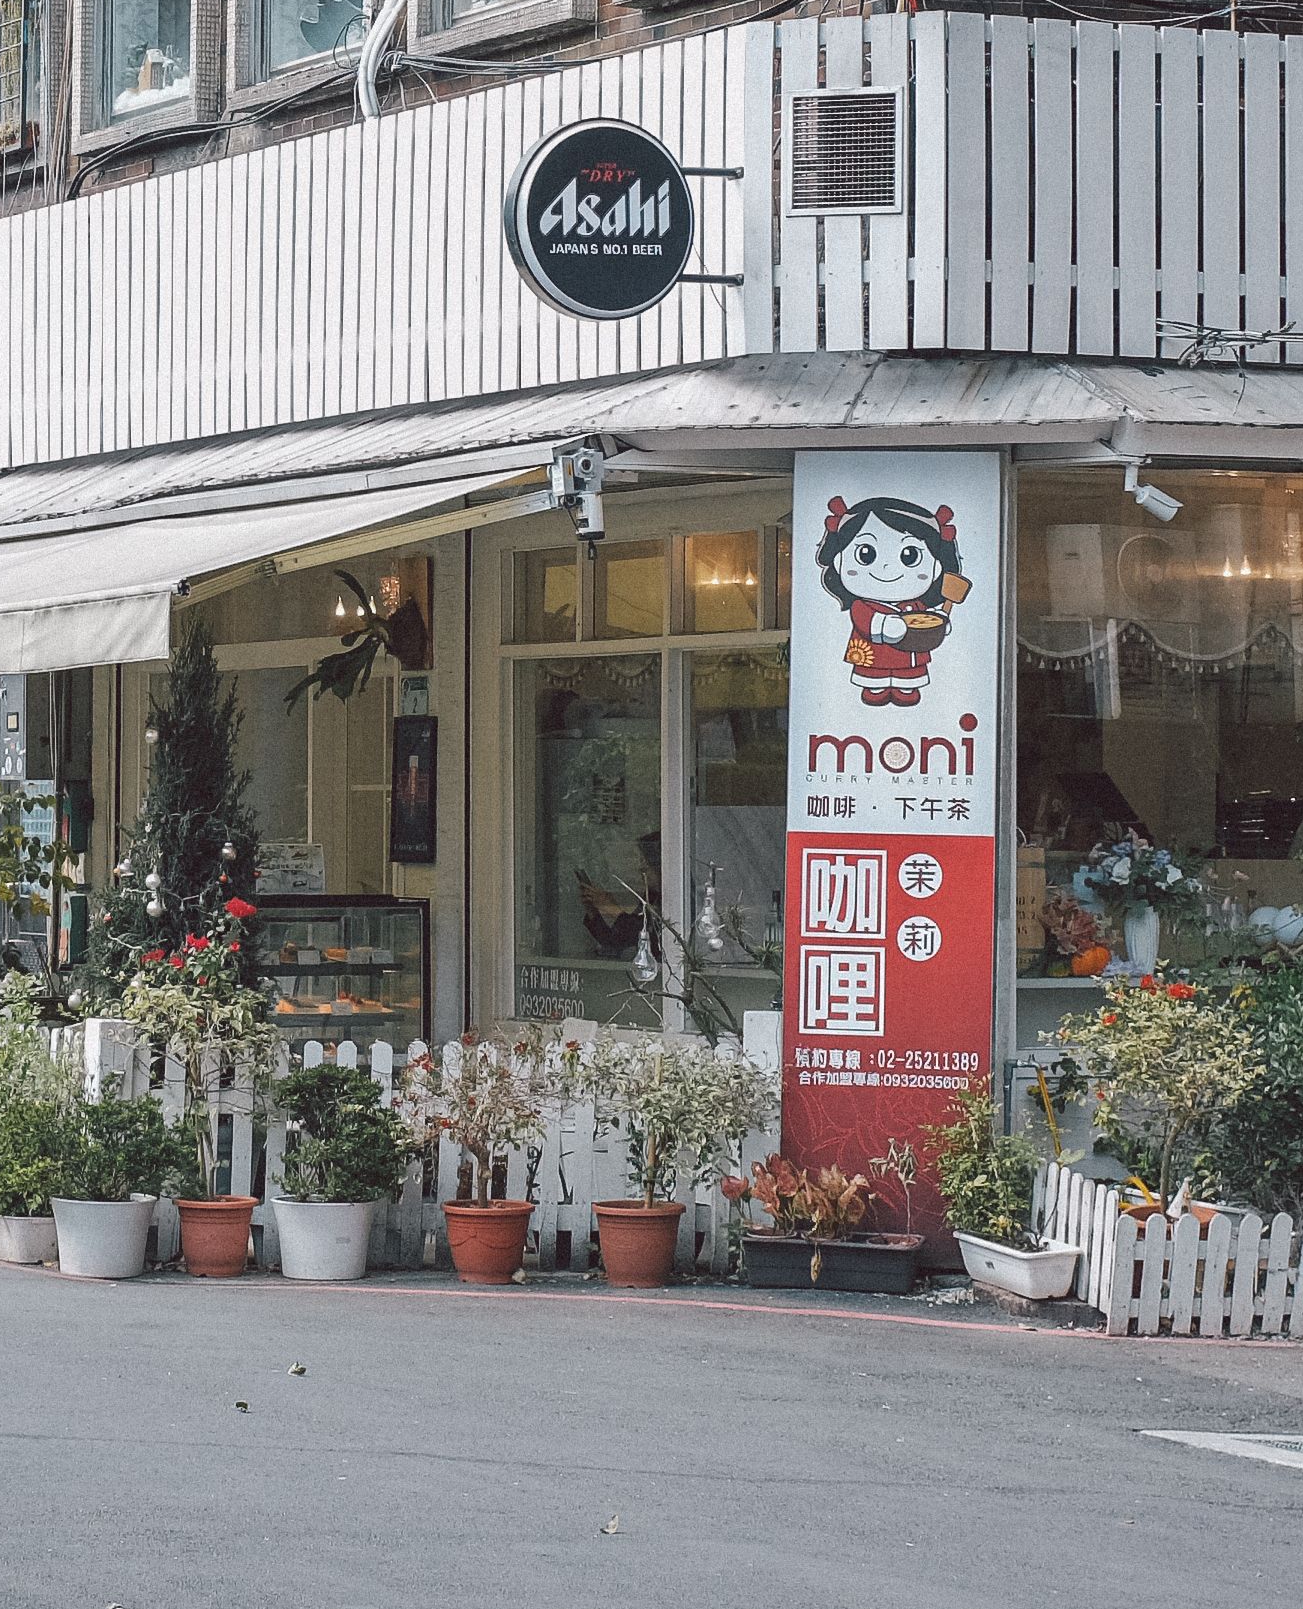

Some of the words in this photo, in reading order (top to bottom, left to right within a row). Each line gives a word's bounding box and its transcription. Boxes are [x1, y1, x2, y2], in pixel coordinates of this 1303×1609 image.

[539, 176, 671, 237] Asahi
[632, 244, 663, 256] BEER
[808, 712, 979, 776] moni
[805, 774, 872, 785] CURRY
[891, 775, 974, 786] MASTER
[807, 794, 857, 819] 咖啡
[894, 796, 971, 821] 下午茶
[903, 859, 937, 957] 茉莉
[807, 855, 879, 1032] 咖哩
[520, 994, 585, 1019] 0932035600
